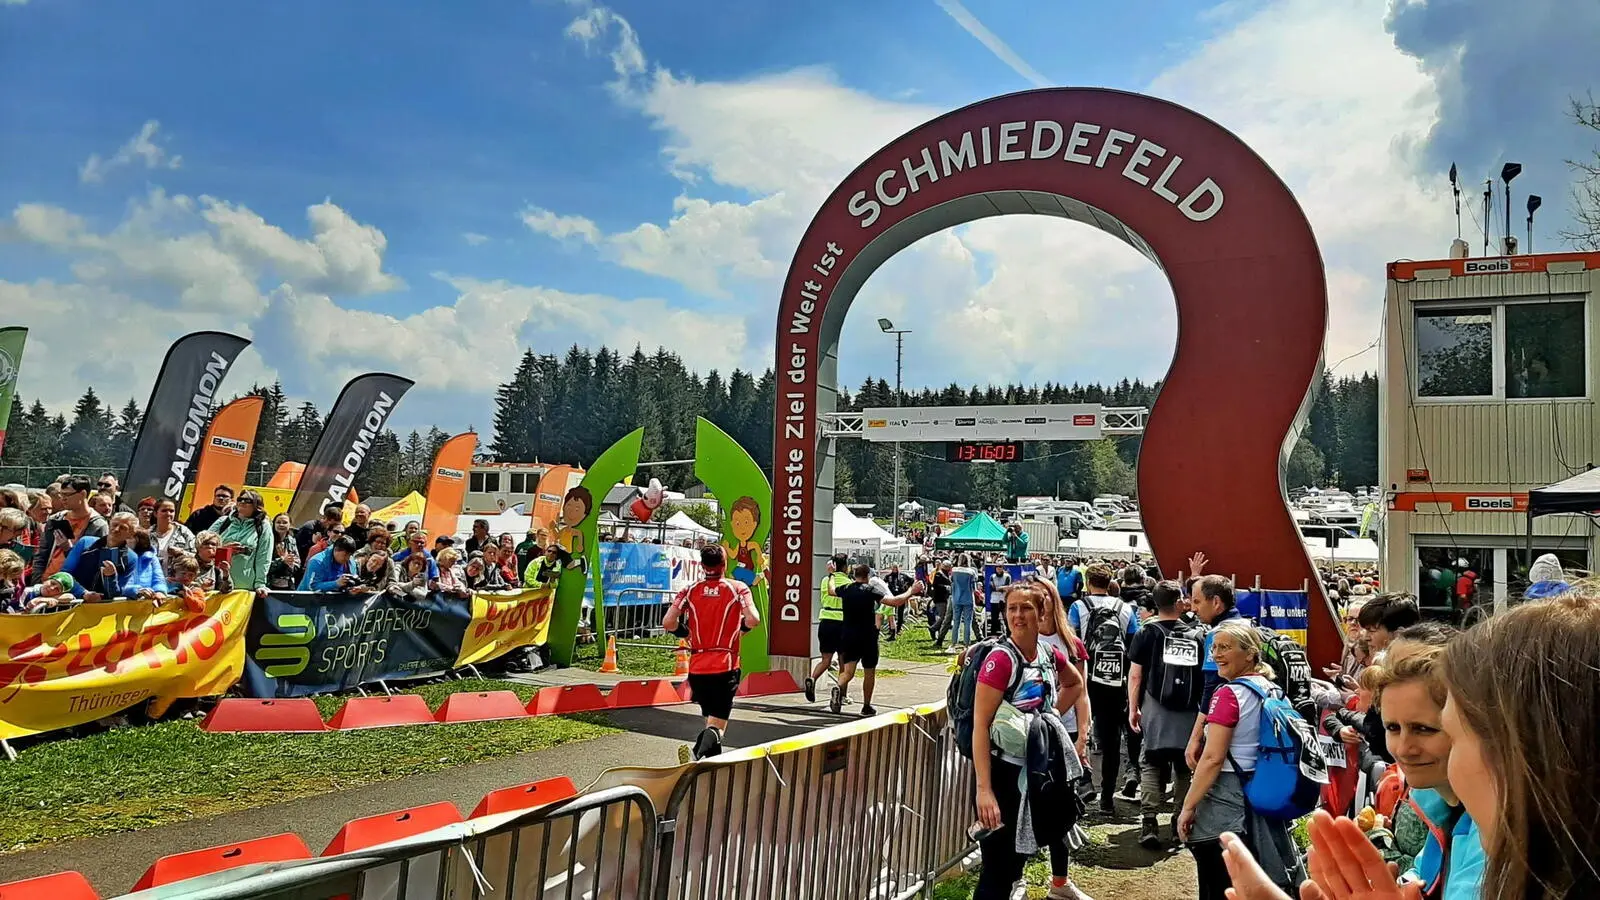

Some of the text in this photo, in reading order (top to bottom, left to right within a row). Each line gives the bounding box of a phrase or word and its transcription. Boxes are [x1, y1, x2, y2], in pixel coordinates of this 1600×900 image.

[848, 120, 1224, 229] SCHMIEDEFELD
[1466, 261, 1509, 272] Boels
[163, 351, 229, 500] SALOMON
[780, 240, 845, 622] Das schönste Ziel der Welt ist
[212, 437, 246, 450] Boels
[959, 445, 1016, 460] 13:16:03
[438, 468, 463, 478] Boels
[1468, 499, 1512, 508] Boels
[318, 639, 387, 673] SPORTS
[1096, 660, 1121, 673] 42216
[69, 688, 150, 713] Thüringen
